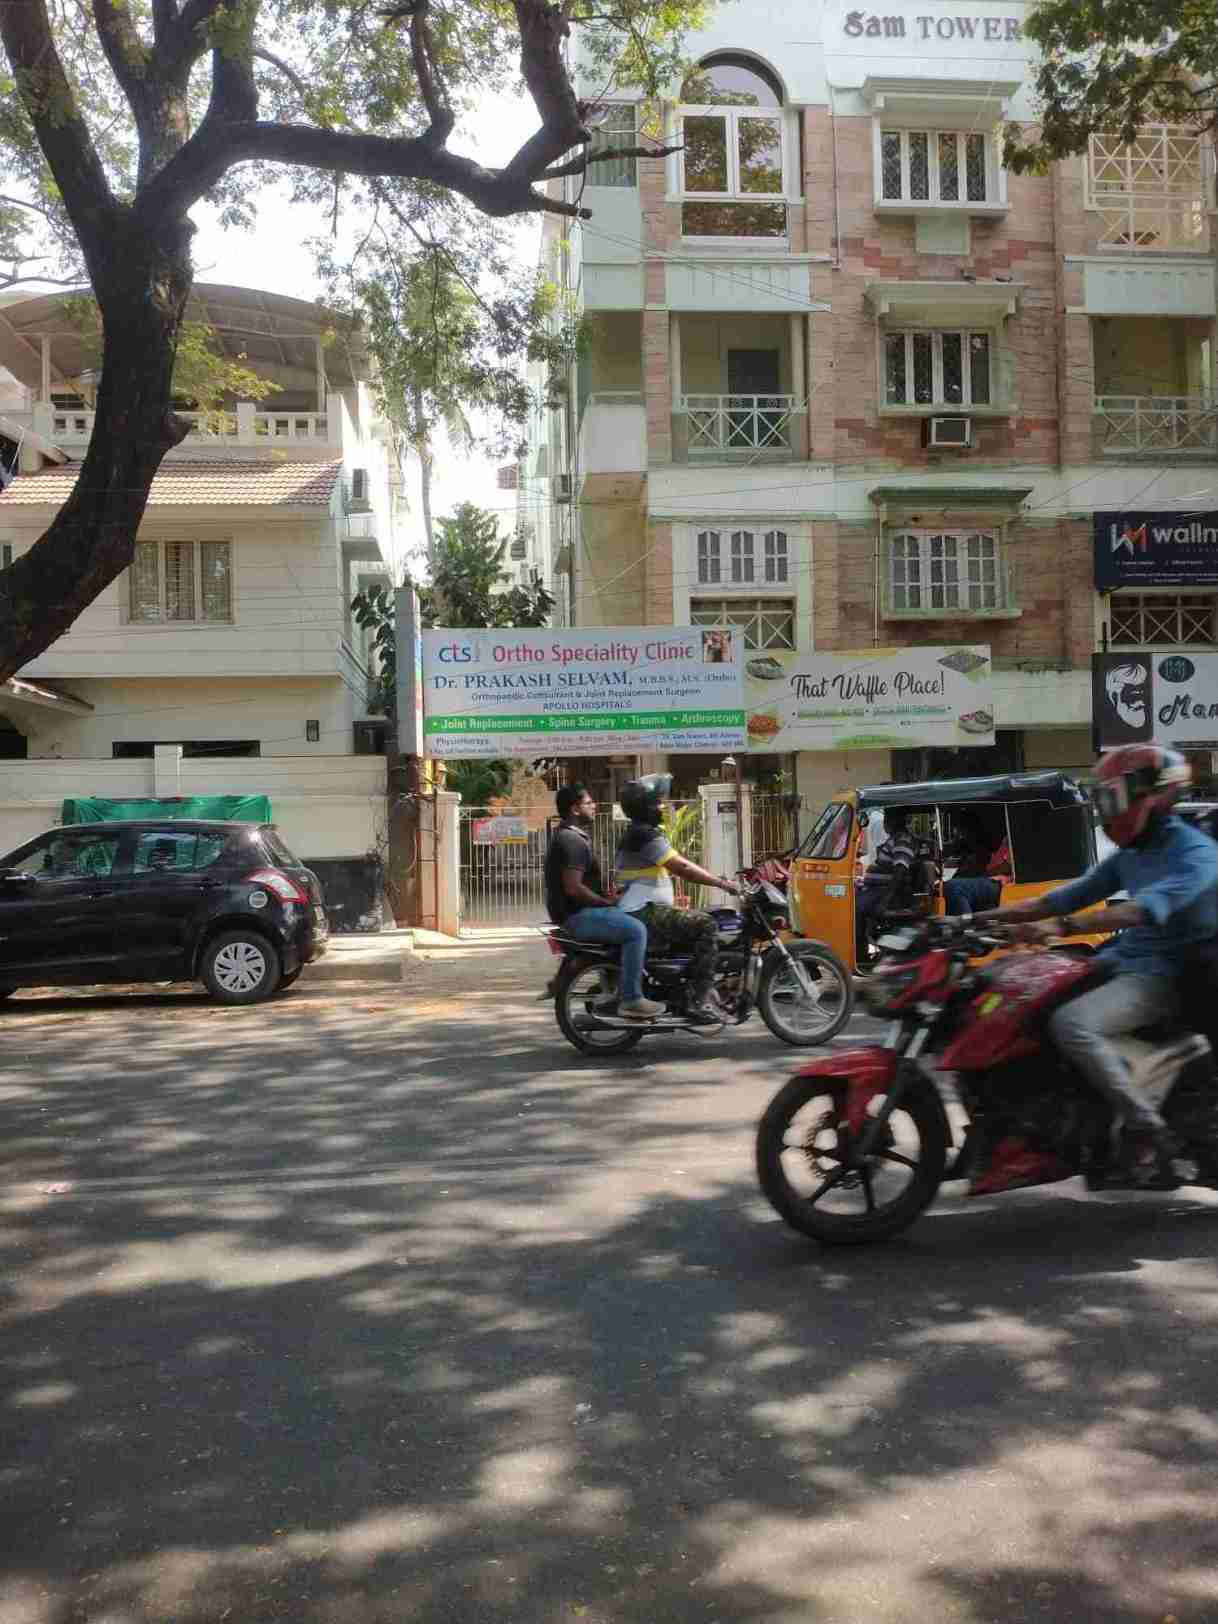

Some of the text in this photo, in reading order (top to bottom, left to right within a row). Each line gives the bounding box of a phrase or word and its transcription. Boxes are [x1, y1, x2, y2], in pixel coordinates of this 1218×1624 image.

[843, 11, 906, 38] Sam
[493, 642, 694, 666] Ortho Speciality Clinic
[434, 675, 457, 688] Dr.
[464, 673, 552, 688] PRAKASH
[790, 670, 945, 703] That Waffle Place!
[528, 689, 573, 699] Consultant
[584, 688, 606, 698] Joint
[608, 687, 663, 698] Replacement
[665, 686, 702, 697] Surgeon
[543, 700, 632, 711] APOLLO HOSPITALS
[440, 711, 740, 730] Joint Replacement Spine Surgery Trauma Arthroscopy
